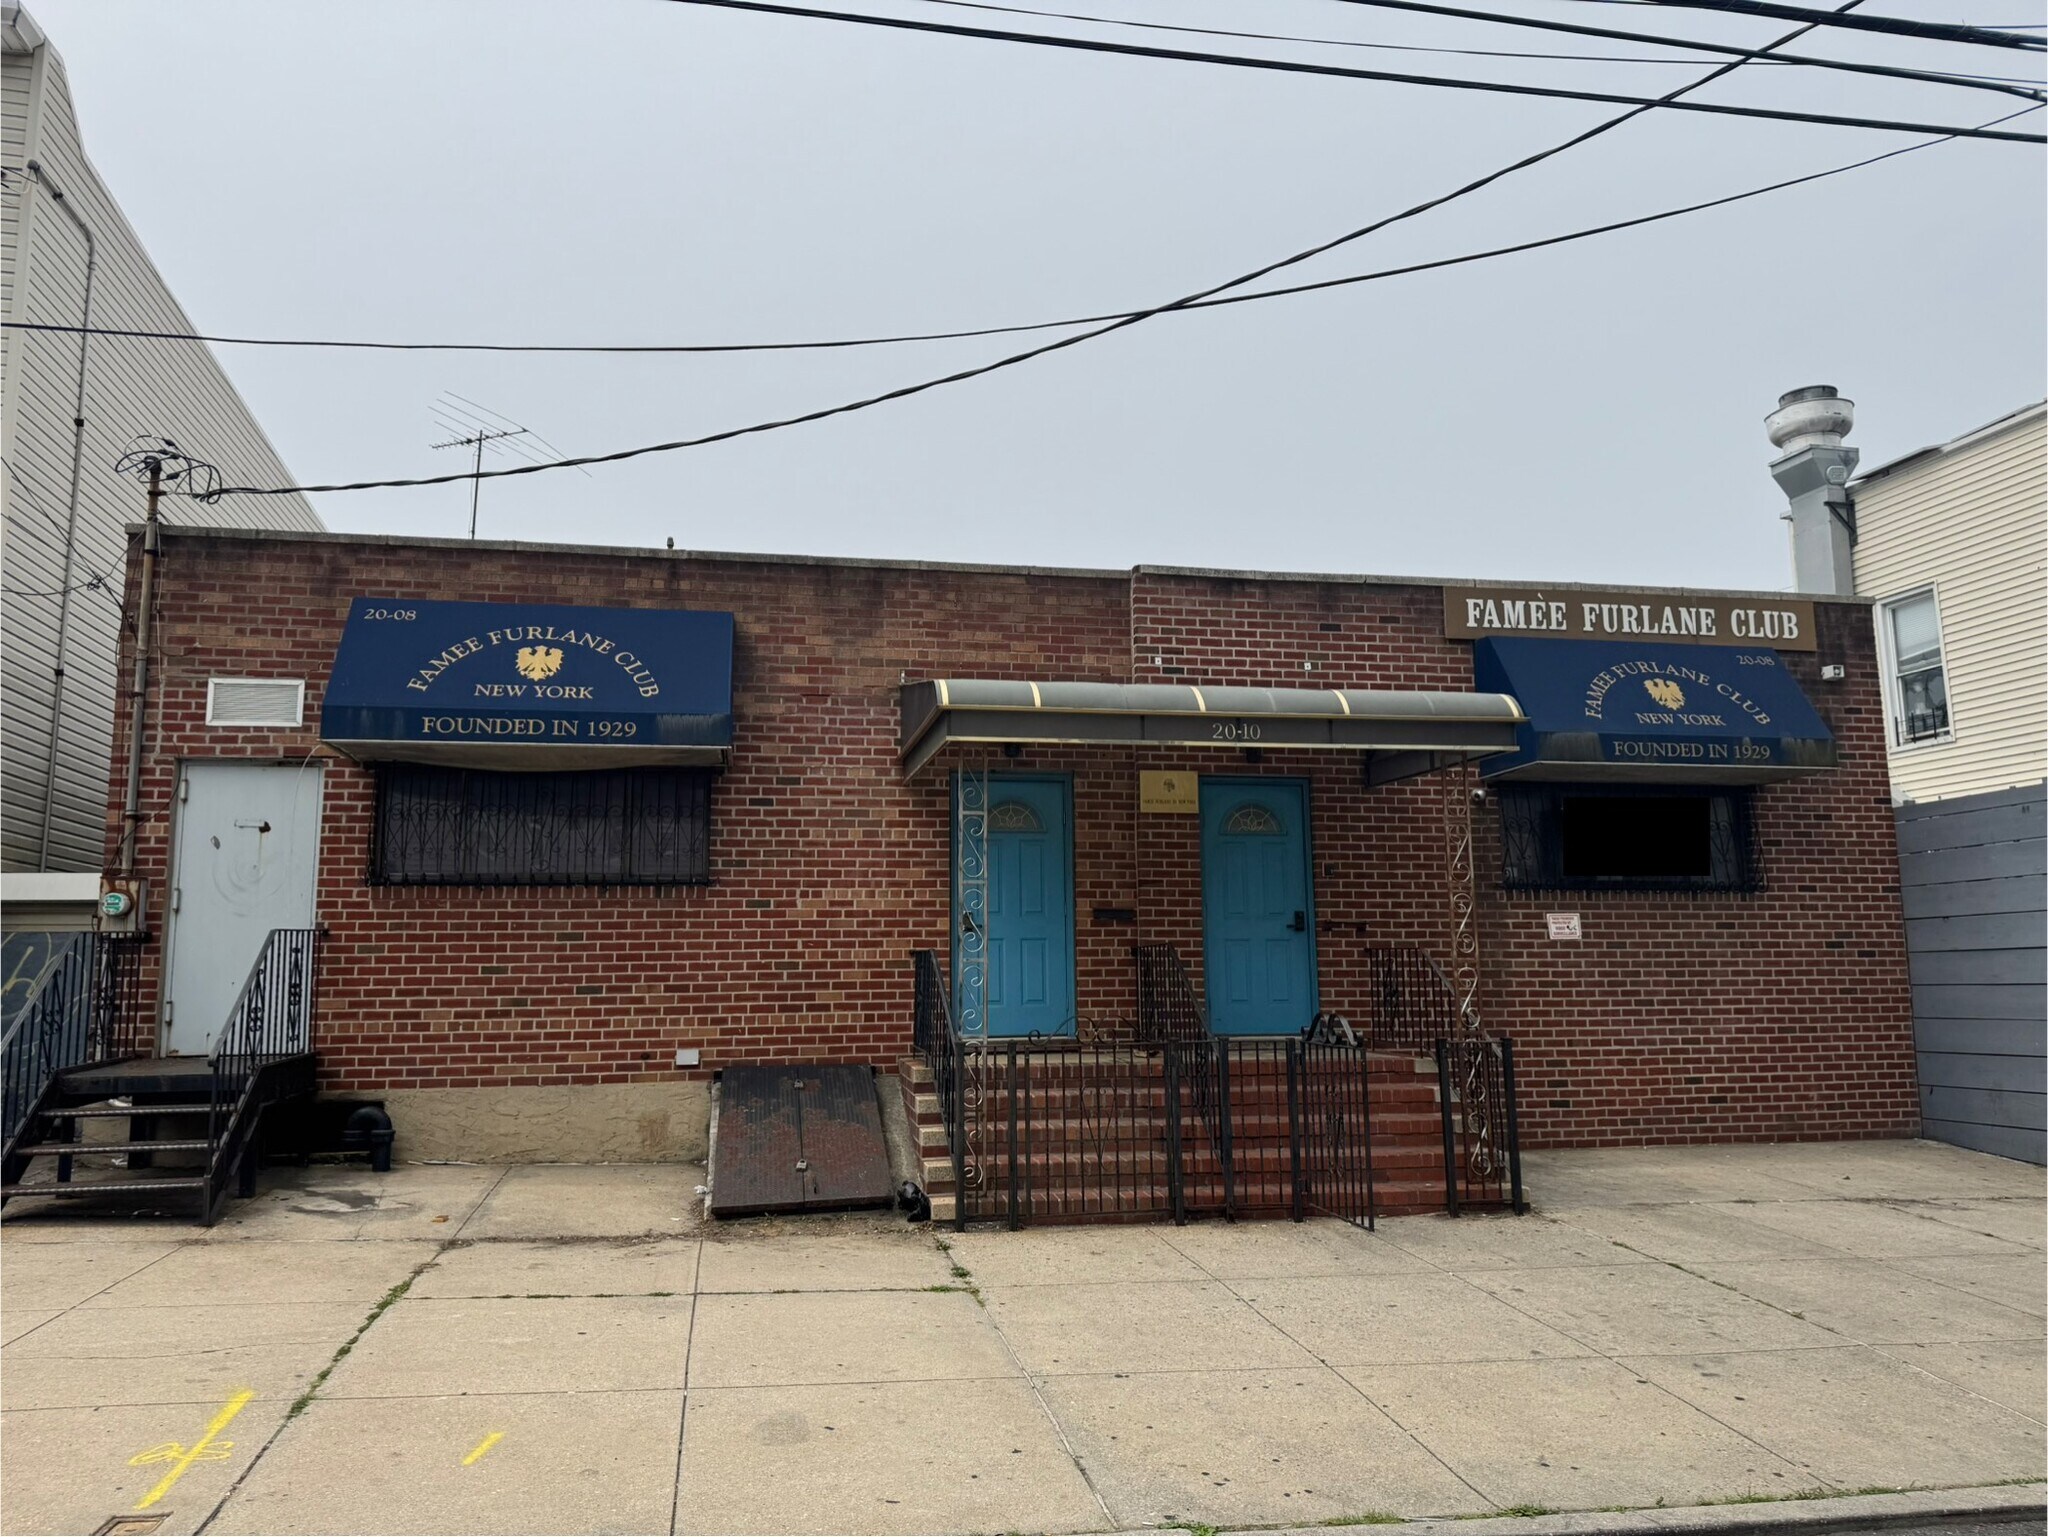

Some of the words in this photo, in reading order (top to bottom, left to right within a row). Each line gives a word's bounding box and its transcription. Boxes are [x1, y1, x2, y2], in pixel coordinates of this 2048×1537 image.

[364, 608, 416, 621] 20-08
[1466, 592, 1567, 631] FAMÈE
[1583, 603, 1716, 637] FURLANE
[1731, 608, 1799, 640] CLUB
[407, 636, 484, 693] FAMEE
[486, 626, 616, 655] FURLANE
[614, 651, 660, 699] CLUB
[1737, 655, 1775, 666] 20-08
[474, 684, 527, 698] NEW
[532, 684, 594, 700] YORK
[1584, 671, 1617, 719] FAMEE
[1614, 661, 1710, 686] FURLANE
[1716, 683, 1771, 725] CLUB
[421, 716, 546, 736] FOUNDED
[552, 719, 579, 737] IN
[587, 720, 638, 738] 1929
[1634, 712, 1674, 725] NEW
[1678, 712, 1727, 727] YORK
[1212, 723, 1261, 740] 20-10
[1613, 740, 1704, 758] FOUNDED
[1708, 743, 1729, 759] IN
[1734, 744, 1771, 760] 1929
